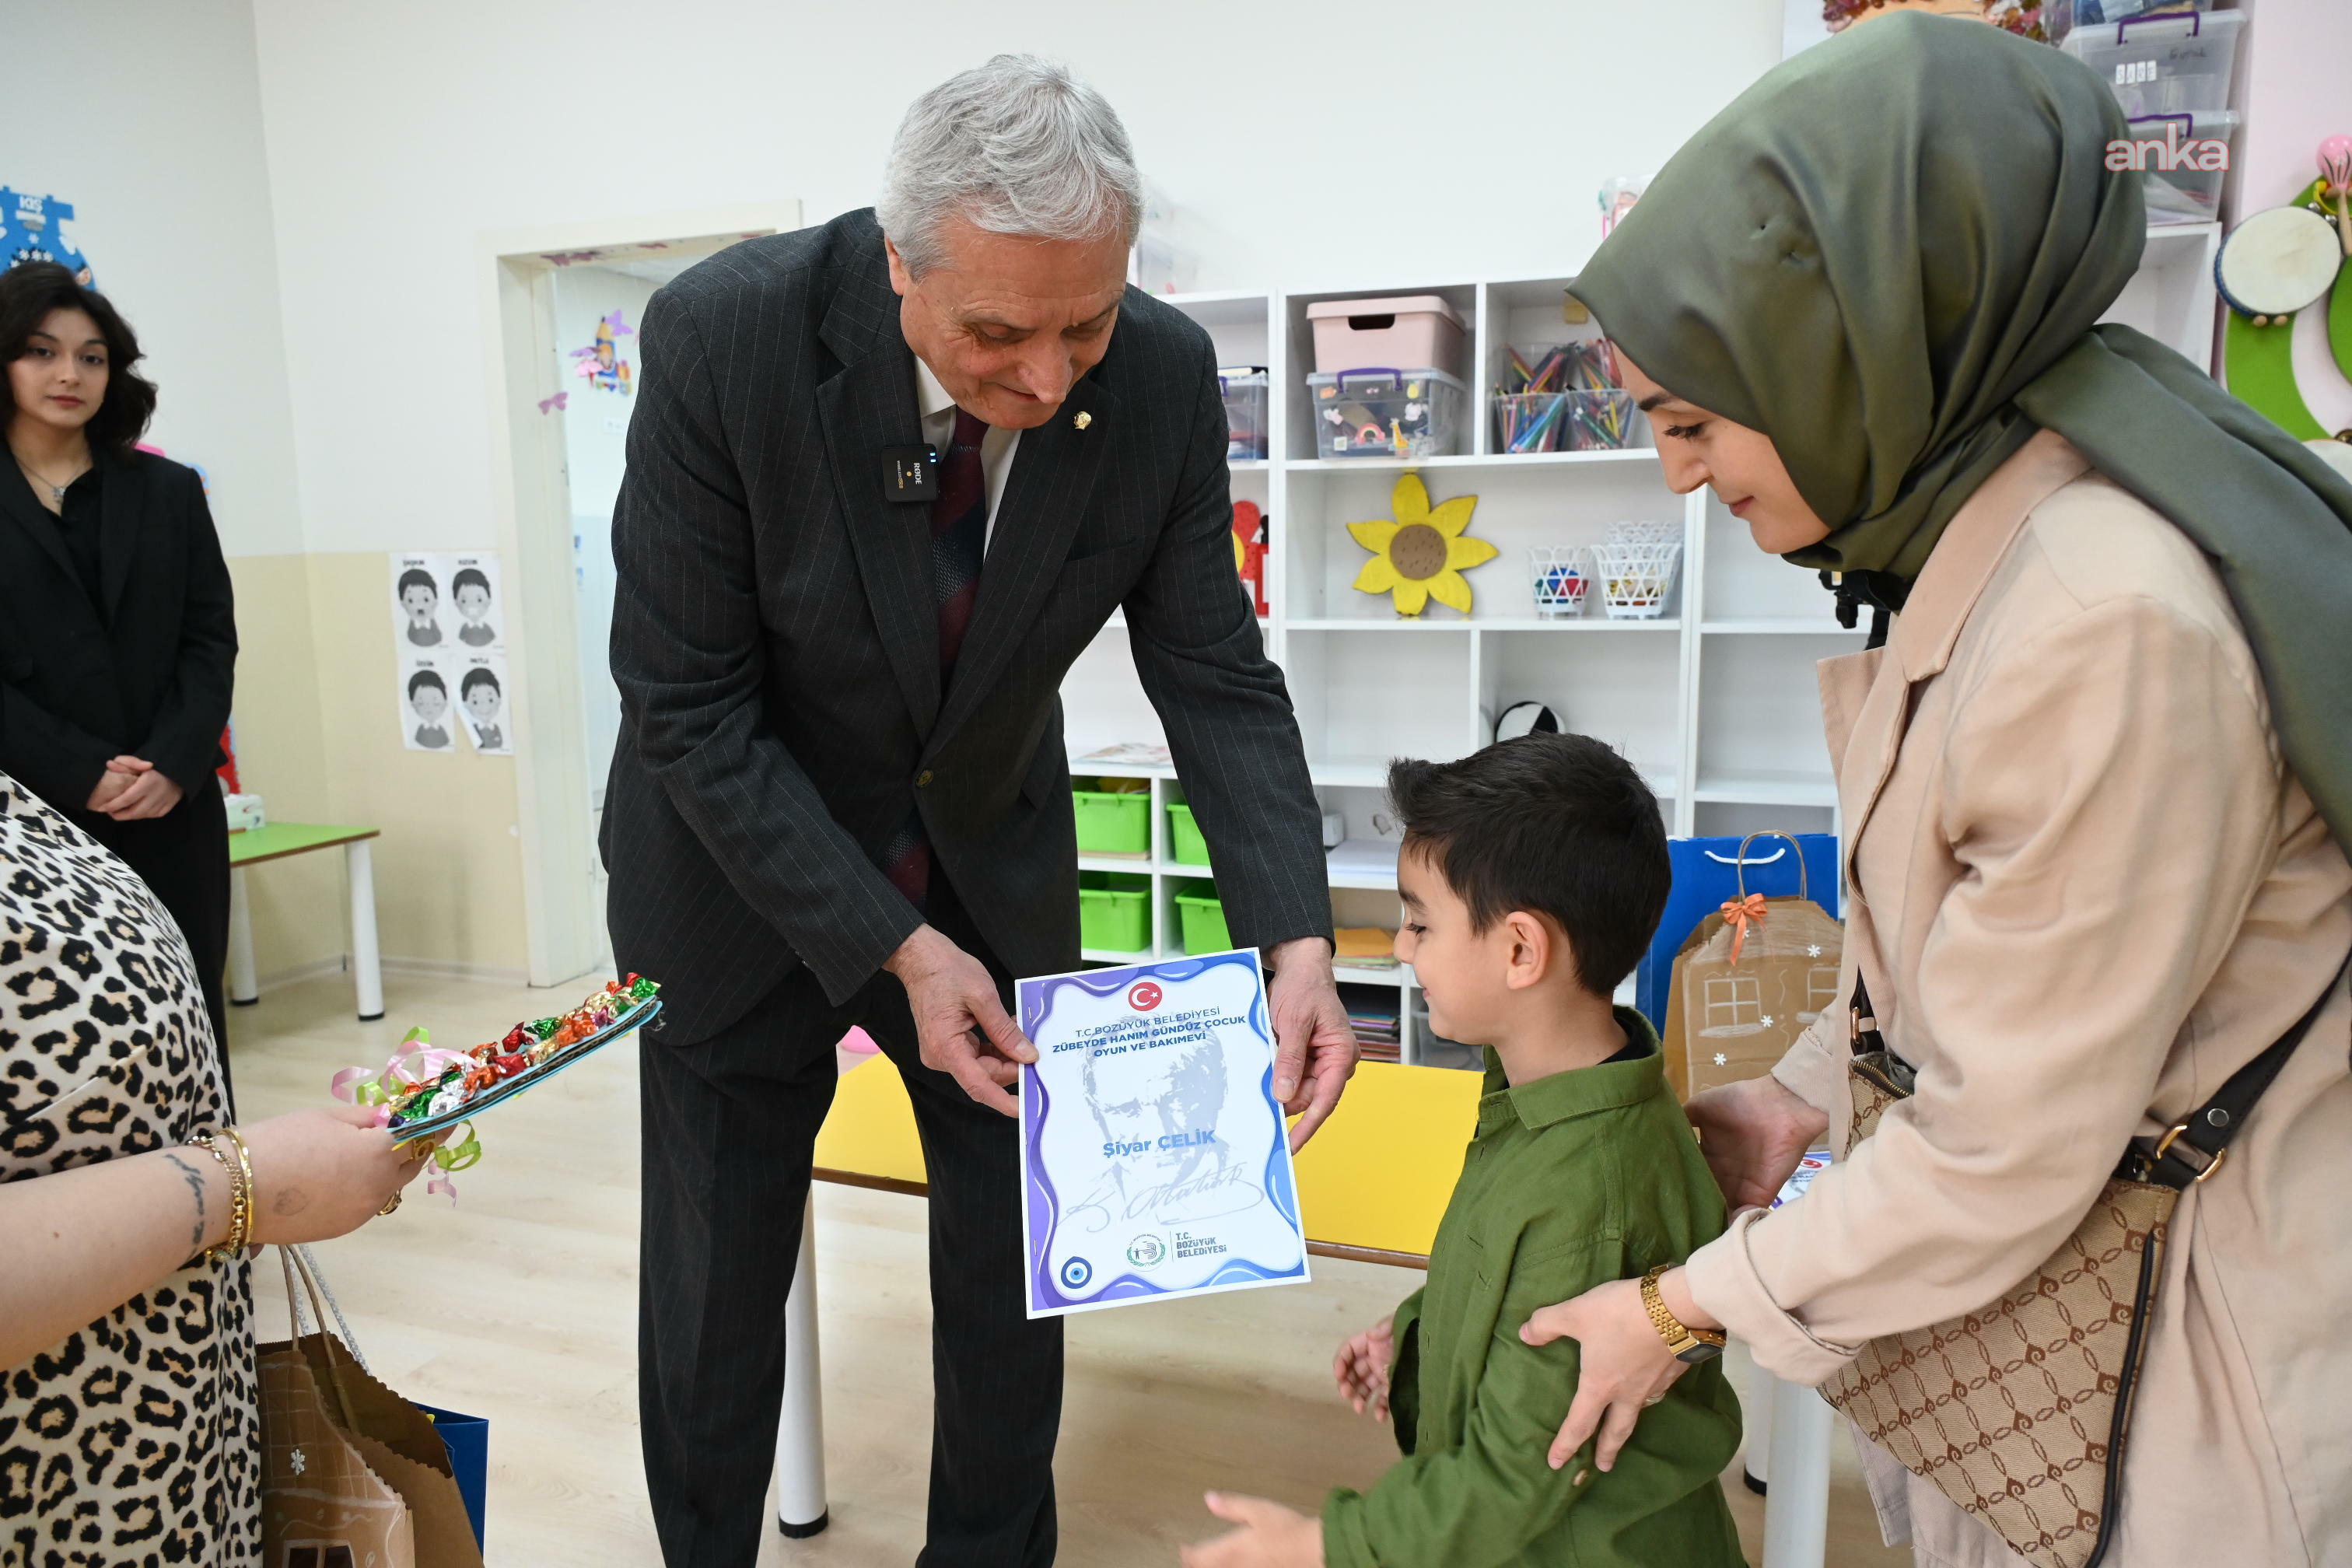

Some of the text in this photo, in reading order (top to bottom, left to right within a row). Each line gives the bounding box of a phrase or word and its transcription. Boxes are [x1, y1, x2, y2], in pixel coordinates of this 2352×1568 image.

[1154, 1006, 1220, 1025] BELEDİYESİ
[1052, 1016, 1246, 1053] ZÜBEYDE HANIM GÜNDÜZ ÇOCUK
[1094, 1031, 1206, 1057] OYUN VE BAKIMEVİ
[1103, 1128, 1216, 1158] Şiyar ÇELİK
[1175, 1231, 1192, 1241] T.C.
[1176, 1237, 1216, 1250] BOZÜYÜK
[1177, 1244, 1227, 1258] BELEDİYESİ
